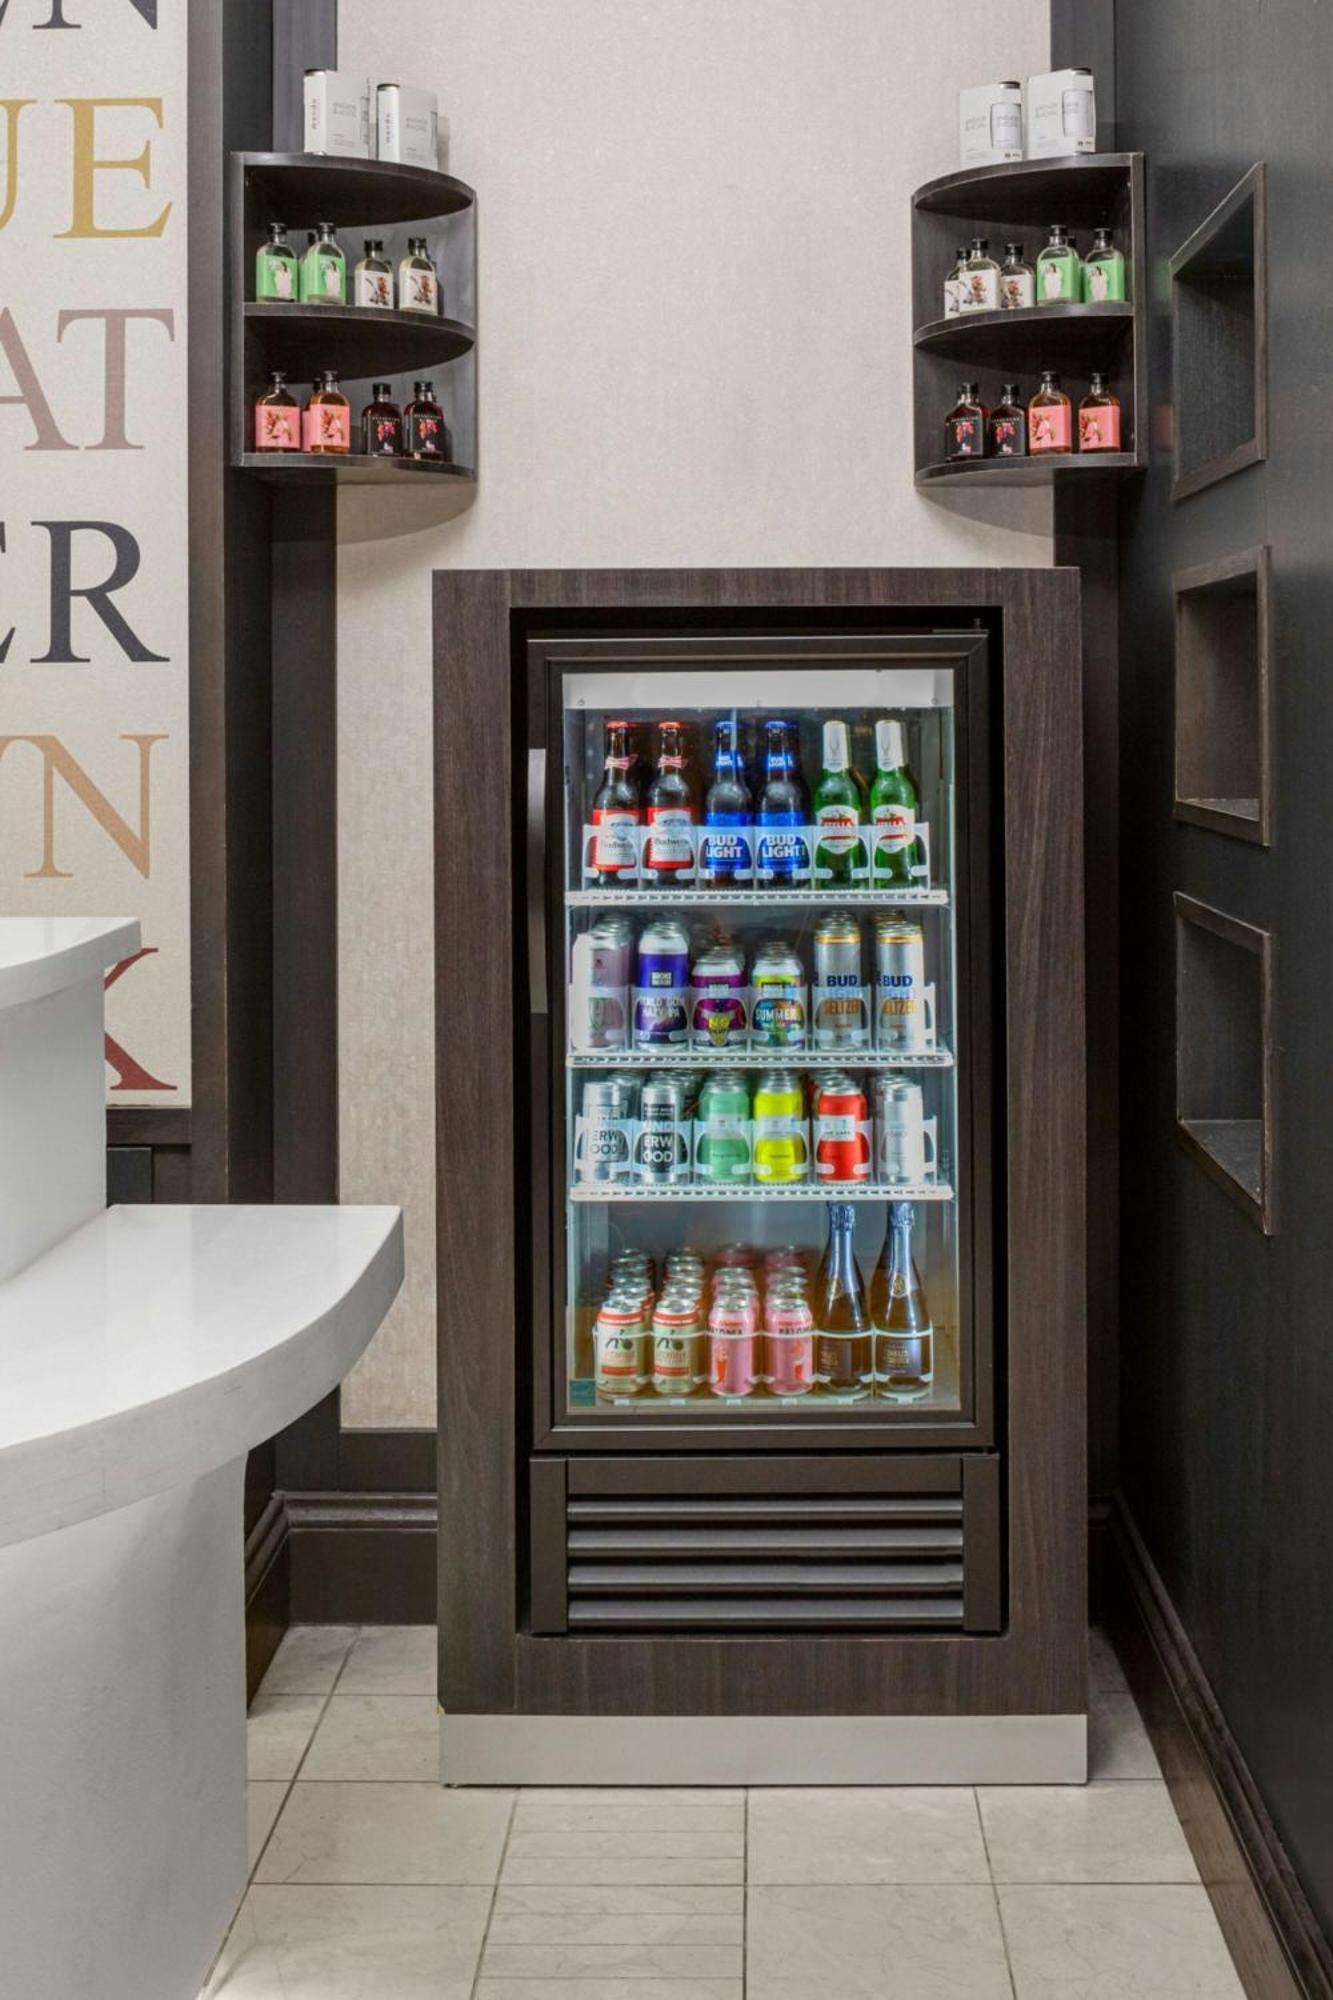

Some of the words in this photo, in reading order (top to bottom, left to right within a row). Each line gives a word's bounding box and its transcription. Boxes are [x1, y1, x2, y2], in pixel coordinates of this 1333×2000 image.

[0, 307, 174, 450] AT
[0, 520, 170, 663] R
[708, 834, 738, 846] BUD
[766, 834, 797, 846] BUD
[761, 846, 800, 858] LIGHT
[827, 975, 857, 987] BUD
[883, 975, 913, 987] BUD
[643, 1135, 674, 1148] ERW
[643, 1150, 674, 1163] OOD
